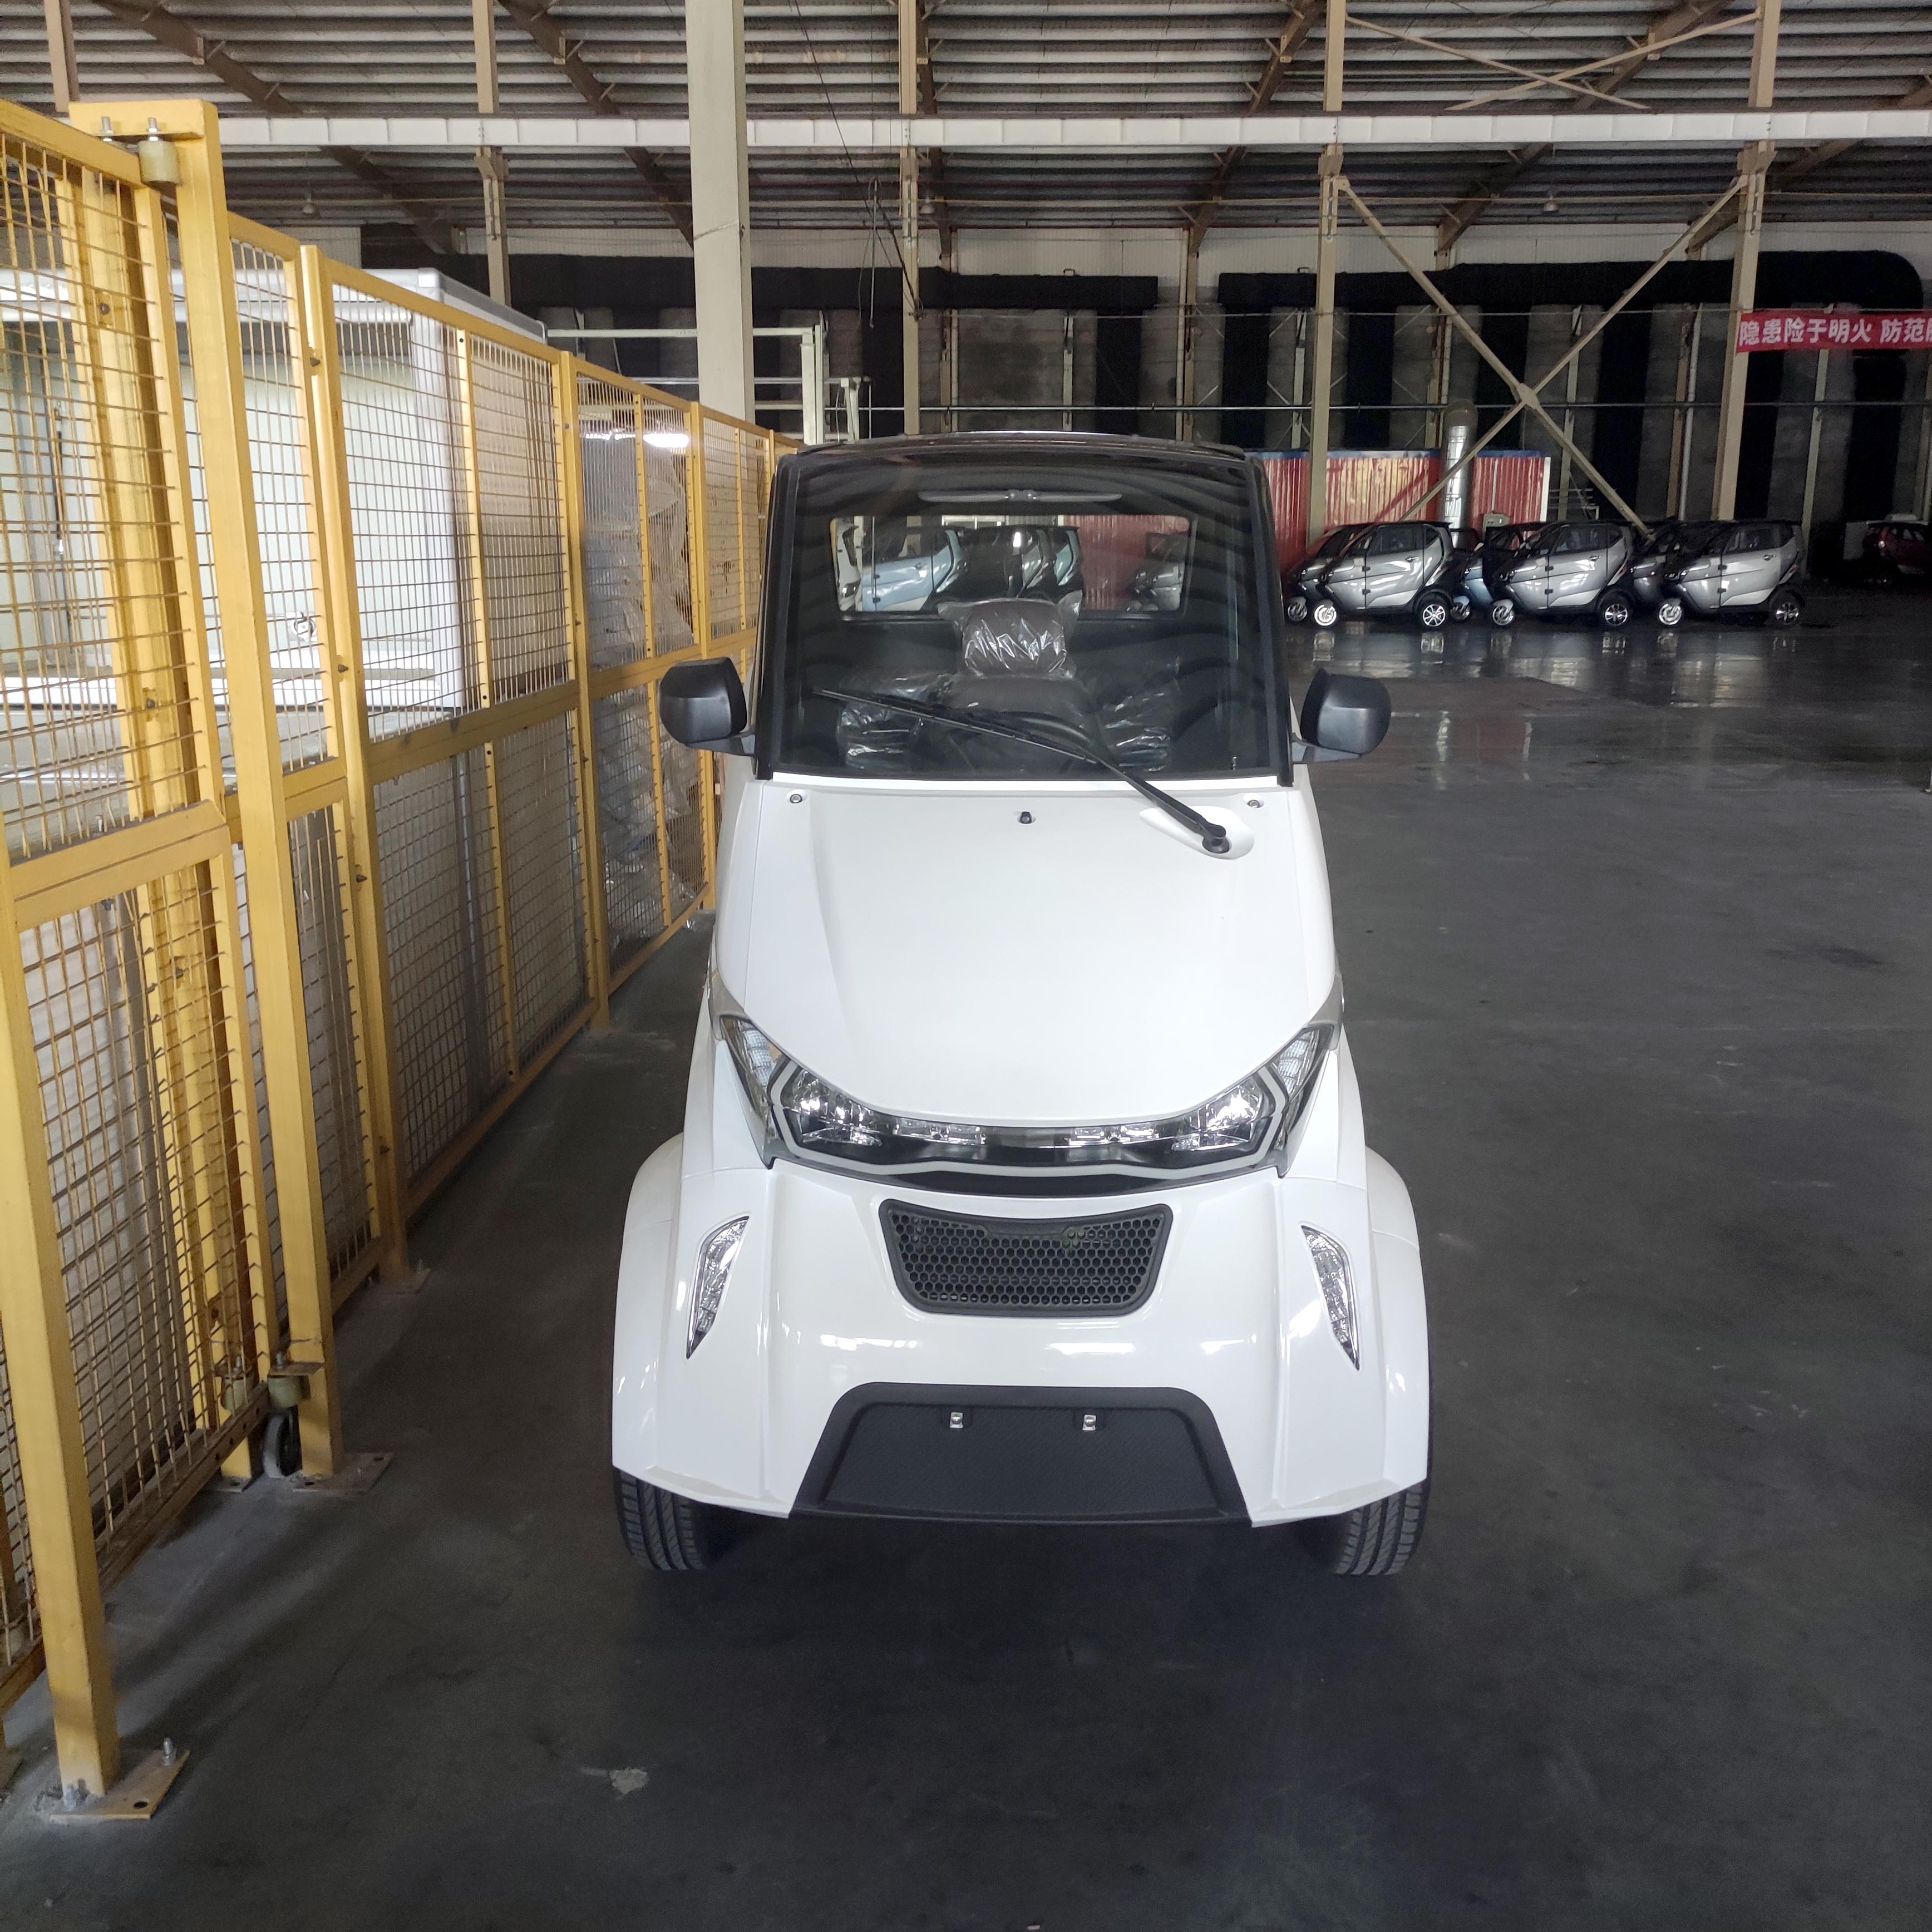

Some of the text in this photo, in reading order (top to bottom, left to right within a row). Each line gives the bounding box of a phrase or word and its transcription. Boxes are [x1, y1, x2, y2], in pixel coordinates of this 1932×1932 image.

[1739, 317, 1871, 346] 隐患险于明火
